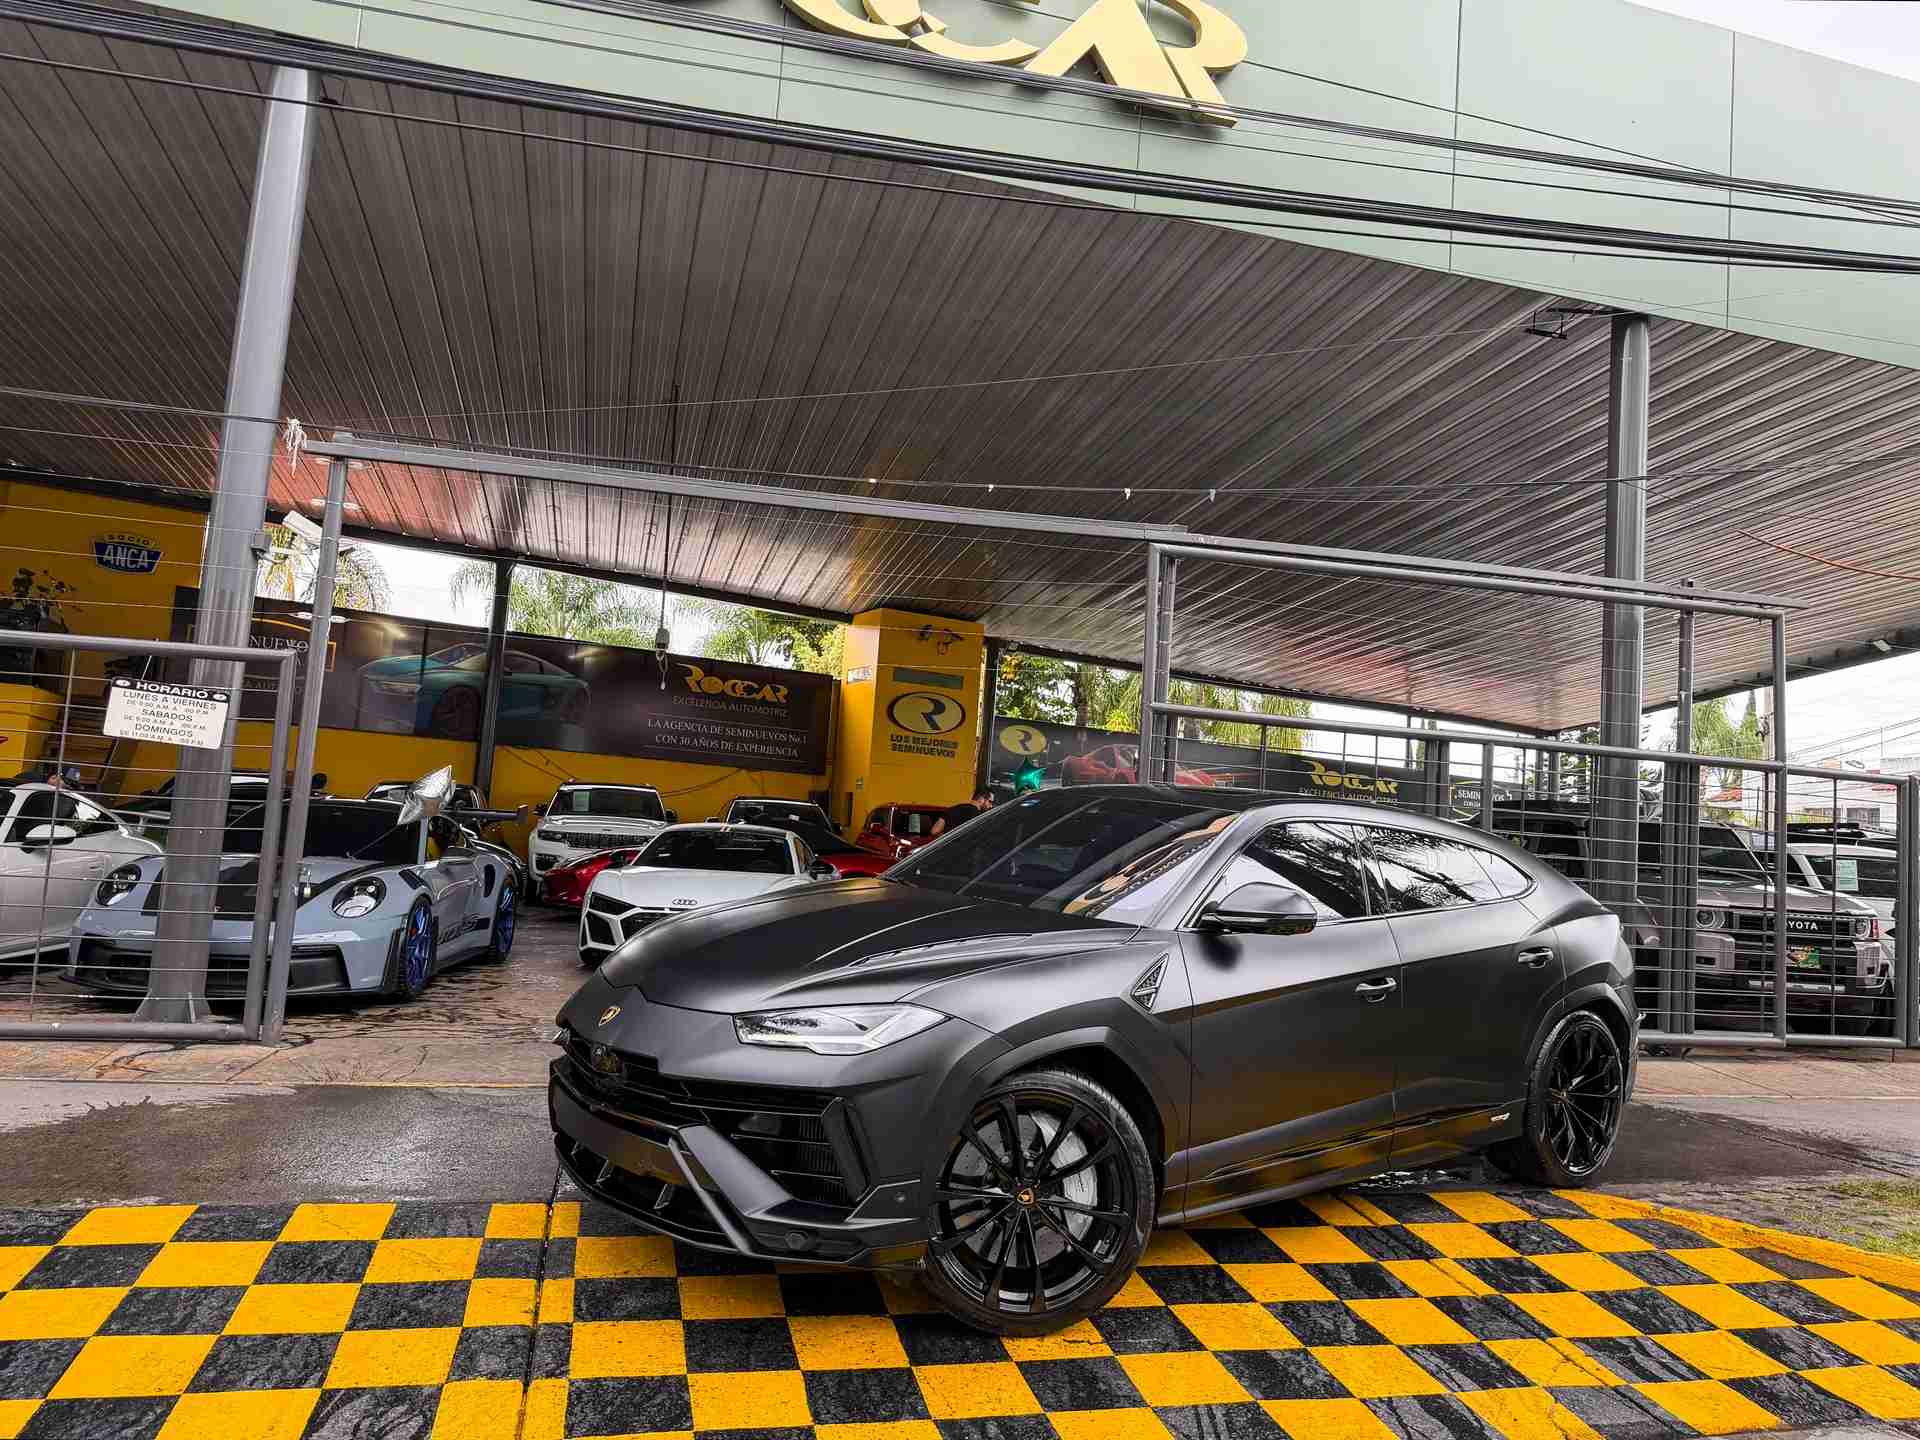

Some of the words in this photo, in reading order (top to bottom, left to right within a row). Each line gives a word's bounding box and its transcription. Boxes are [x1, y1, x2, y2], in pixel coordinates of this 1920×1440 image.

[103, 544, 149, 568] ANCA
[136, 681, 208, 699] HORARIO
[122, 690, 159, 703] LUNES
[172, 697, 217, 711] VIERNES
[141, 709, 193, 722] SABADOS
[135, 723, 193, 738] DOMINGOS
[891, 743, 956, 758] SEMINUEVOS
[1786, 920, 1819, 931] YOTA
